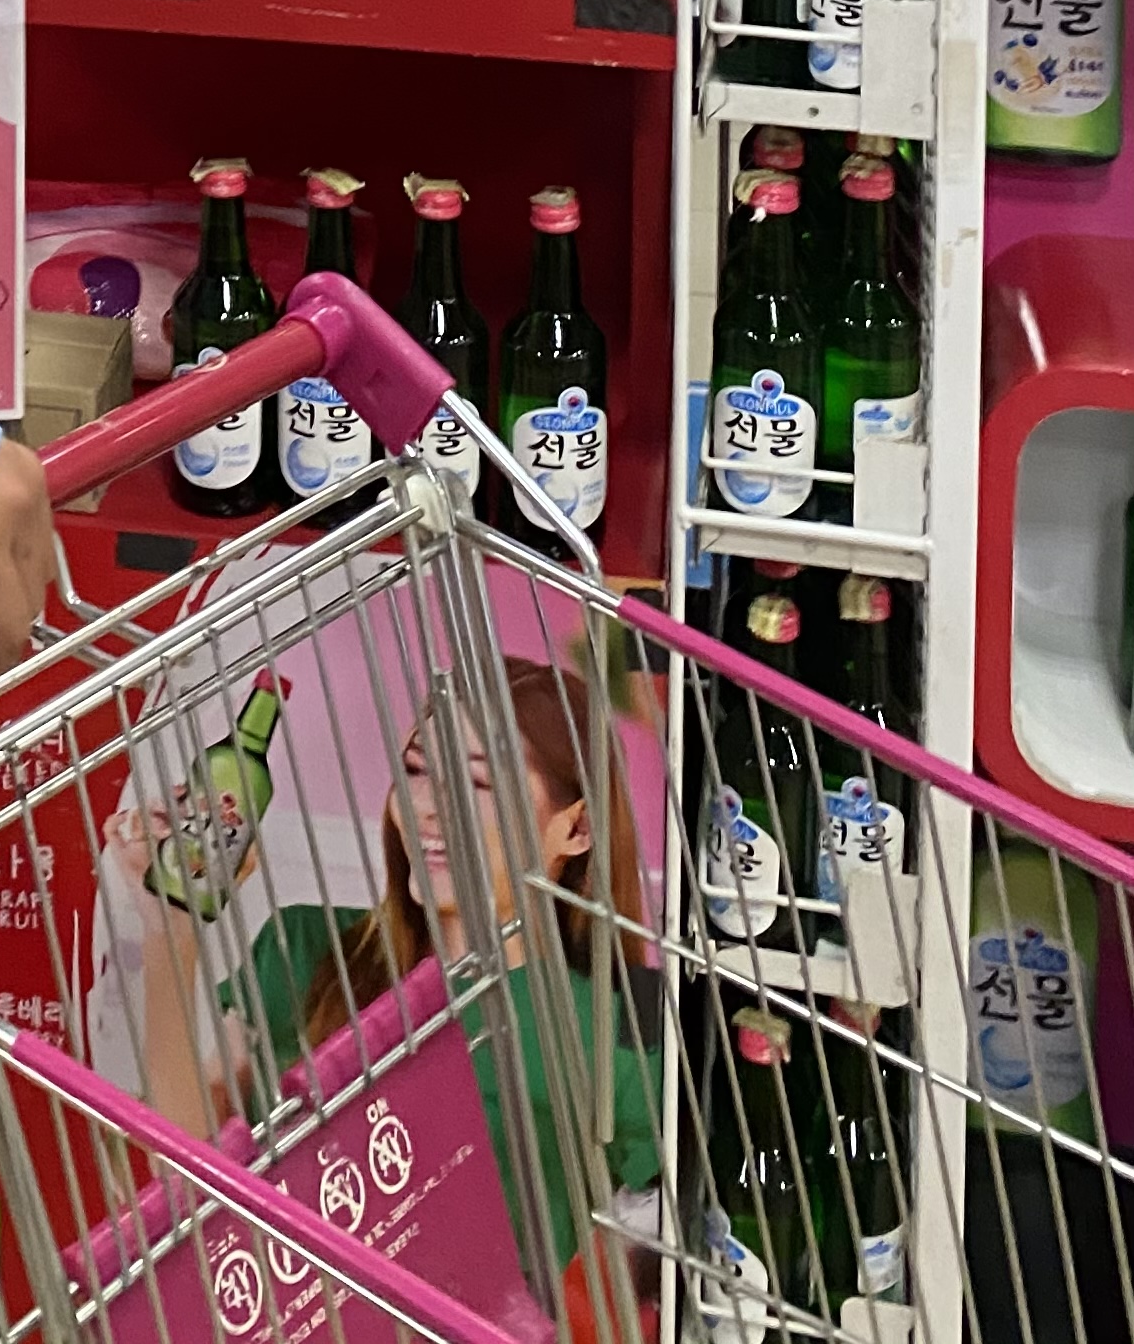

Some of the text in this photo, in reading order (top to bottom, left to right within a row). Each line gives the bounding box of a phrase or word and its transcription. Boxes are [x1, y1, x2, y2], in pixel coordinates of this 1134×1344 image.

[288, 400, 359, 442] 선물
[725, 412, 803, 456] 선물
[528, 431, 601, 470] 선물
[973, 967, 1074, 1031] 선물
